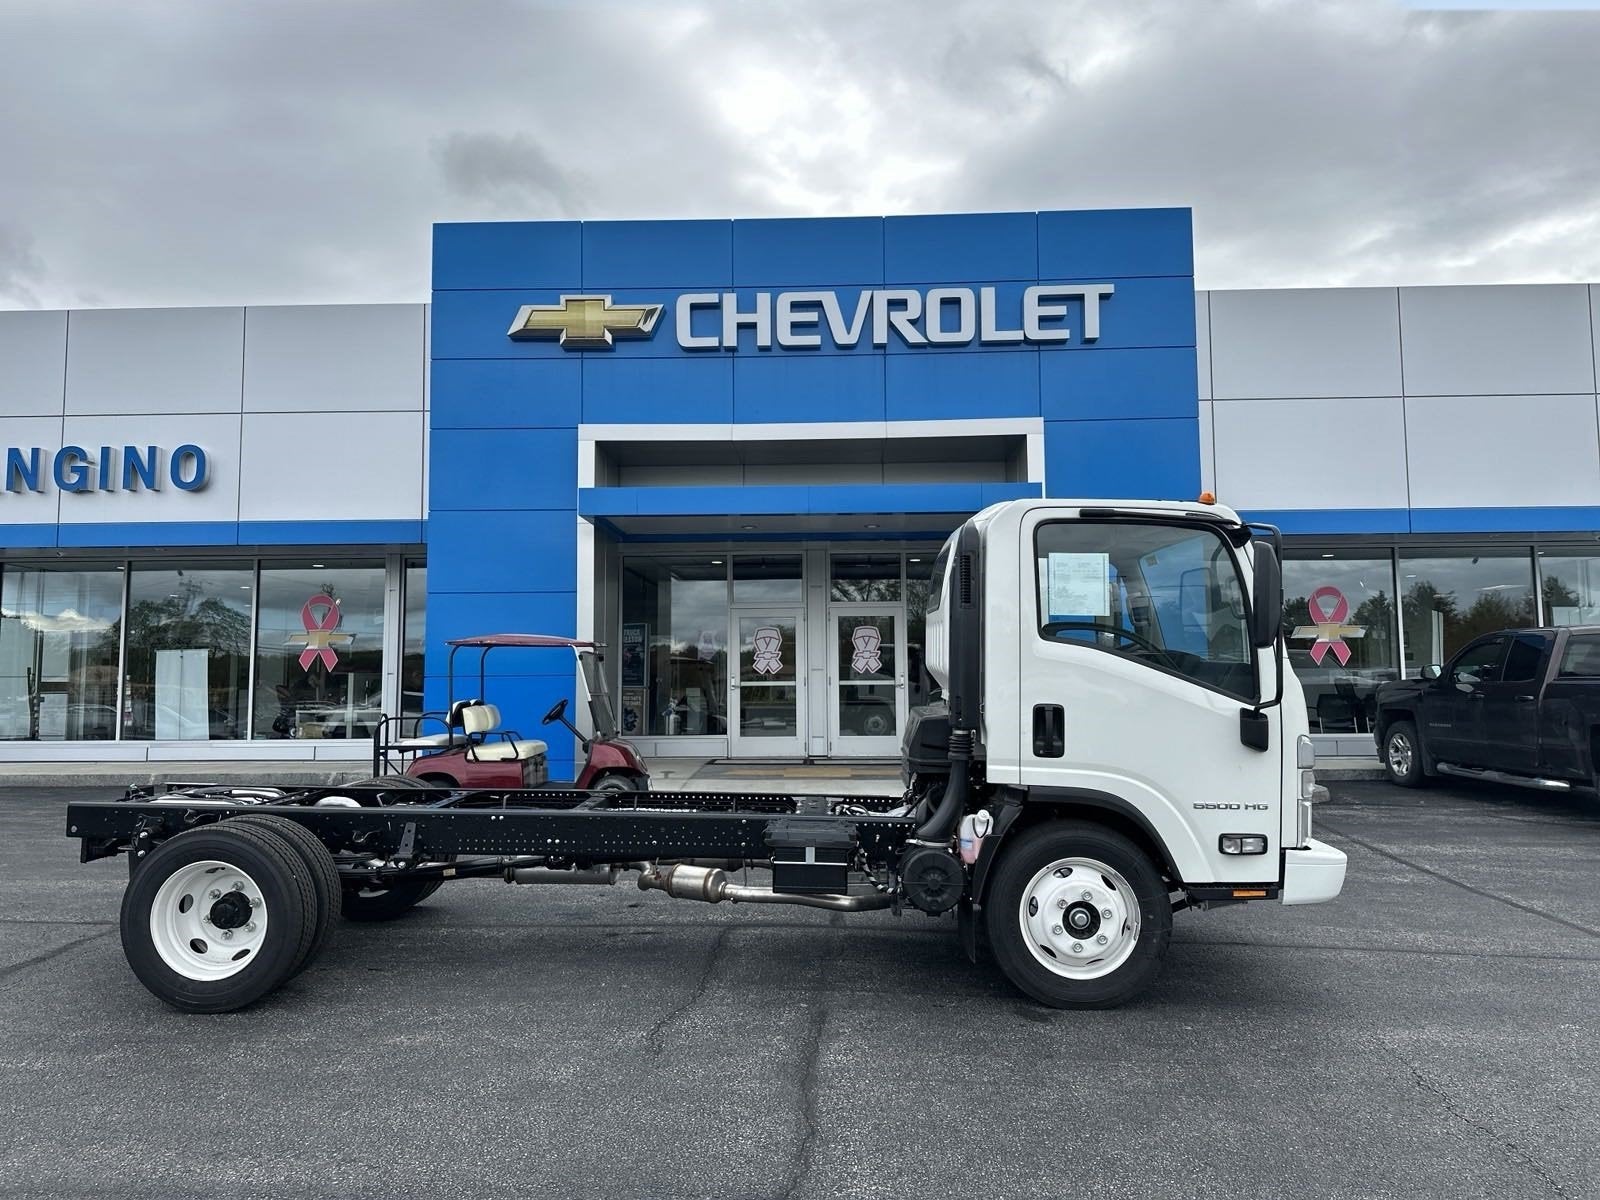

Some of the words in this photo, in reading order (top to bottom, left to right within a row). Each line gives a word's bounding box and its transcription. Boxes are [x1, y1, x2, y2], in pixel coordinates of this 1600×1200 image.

[676, 283, 1116, 350] CHEVROLET
[0, 444, 210, 492] NGINO
[1244, 803, 1269, 811] HG
